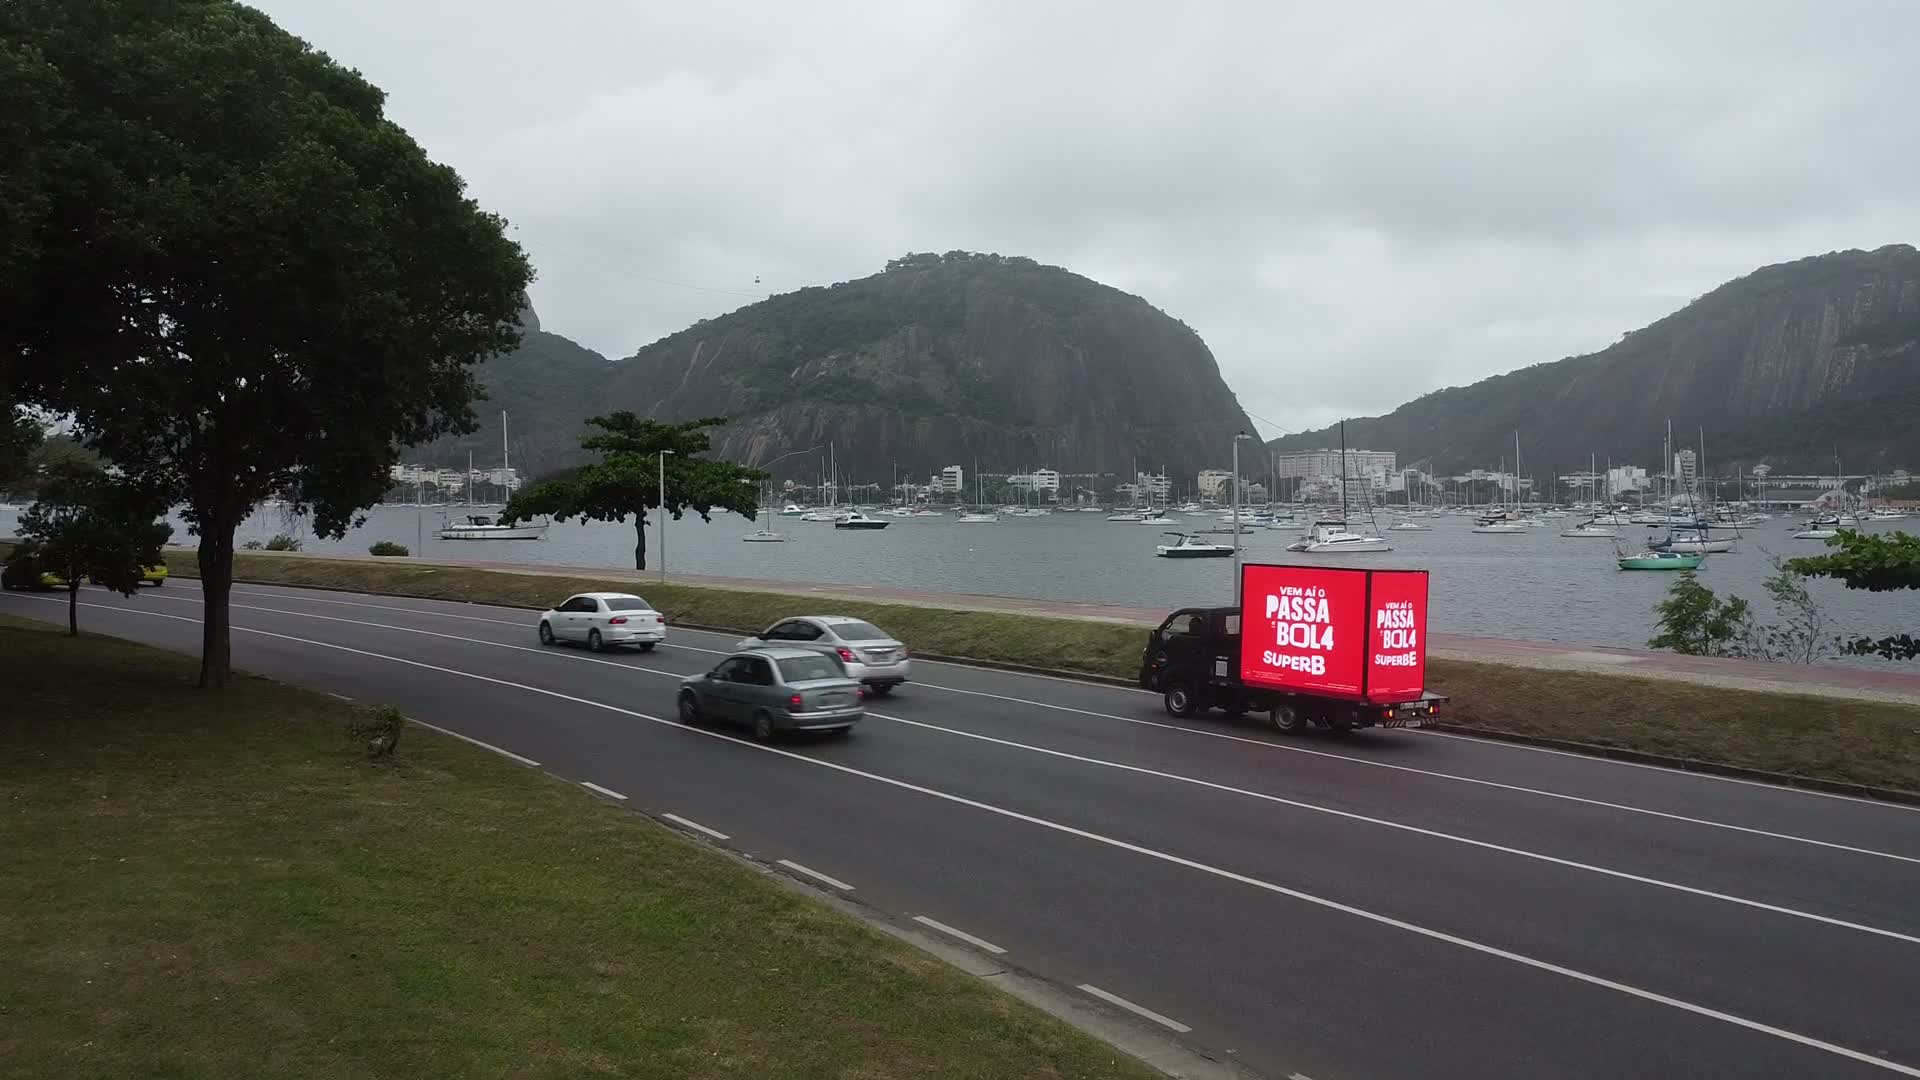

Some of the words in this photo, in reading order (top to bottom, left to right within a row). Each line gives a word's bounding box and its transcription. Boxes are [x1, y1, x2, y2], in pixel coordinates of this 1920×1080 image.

[1280, 586, 1302, 596] VEM
[1304, 586, 1316, 596] AÍ
[1318, 589, 1325, 597] O
[1266, 595, 1330, 623] PASSA
[1377, 609, 1414, 628] PASSA
[1277, 622, 1334, 650] BOL4
[1384, 629, 1416, 648] BOL4
[1263, 650, 1325, 675] SUPERB
[1375, 651, 1416, 666] SUPERBE
